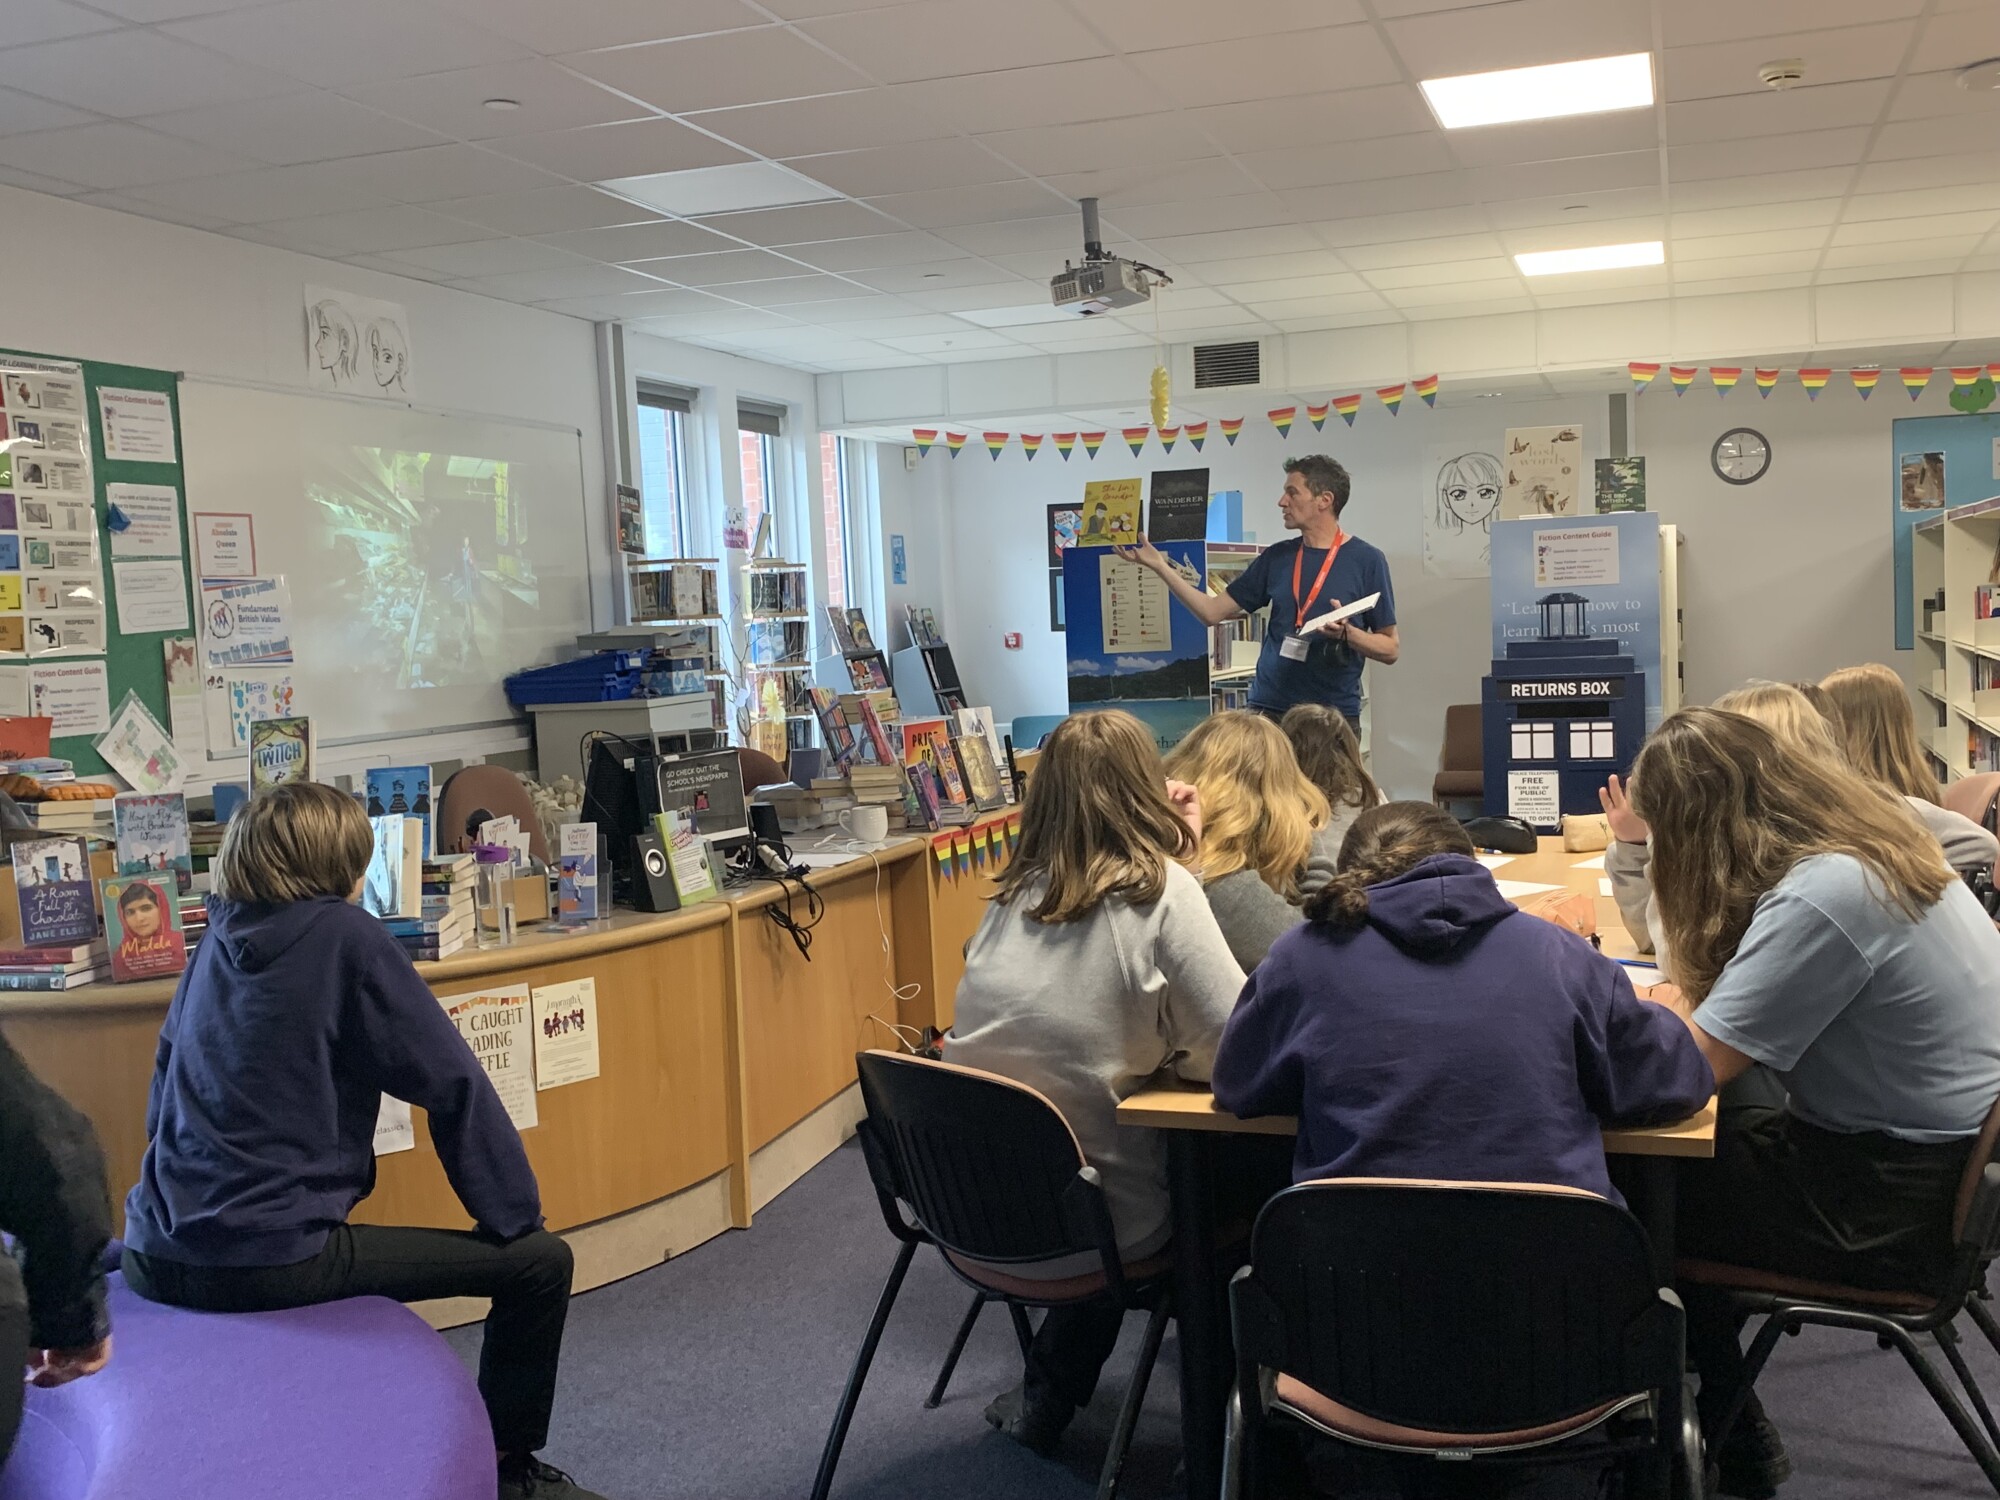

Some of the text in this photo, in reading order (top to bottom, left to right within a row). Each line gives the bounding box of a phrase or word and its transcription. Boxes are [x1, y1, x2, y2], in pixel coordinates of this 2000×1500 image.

[103, 393, 165, 406] Fiction Content Guide
[1154, 495, 1204, 505] WANDERER
[1538, 530, 1612, 542] Fiction Content Guide
[237, 604, 279, 613] Fundamental
[1625, 598, 1641, 611] to
[238, 614, 281, 623] British Values
[1602, 621, 1641, 633] most
[34, 667, 102, 678] Fiction Content Guide
[1511, 682, 1610, 697] RETURNS BOX
[254, 741, 302, 768] TWITCH
[921, 749, 931, 761] OF
[666, 770, 675, 778] GO
[675, 768, 695, 776] CHECK
[695, 765, 708, 773] OUT
[666, 772, 729, 787] SCHOOL'S NEWSPAPER
[128, 811, 145, 821] How
[147, 820, 176, 831] Broken
[32, 887, 80, 900] A Room
[38, 899, 74, 912] Full of
[30, 908, 87, 926] Chocolate
[29, 930, 55, 941] JANE
[470, 1007, 524, 1031] CAUGHT
